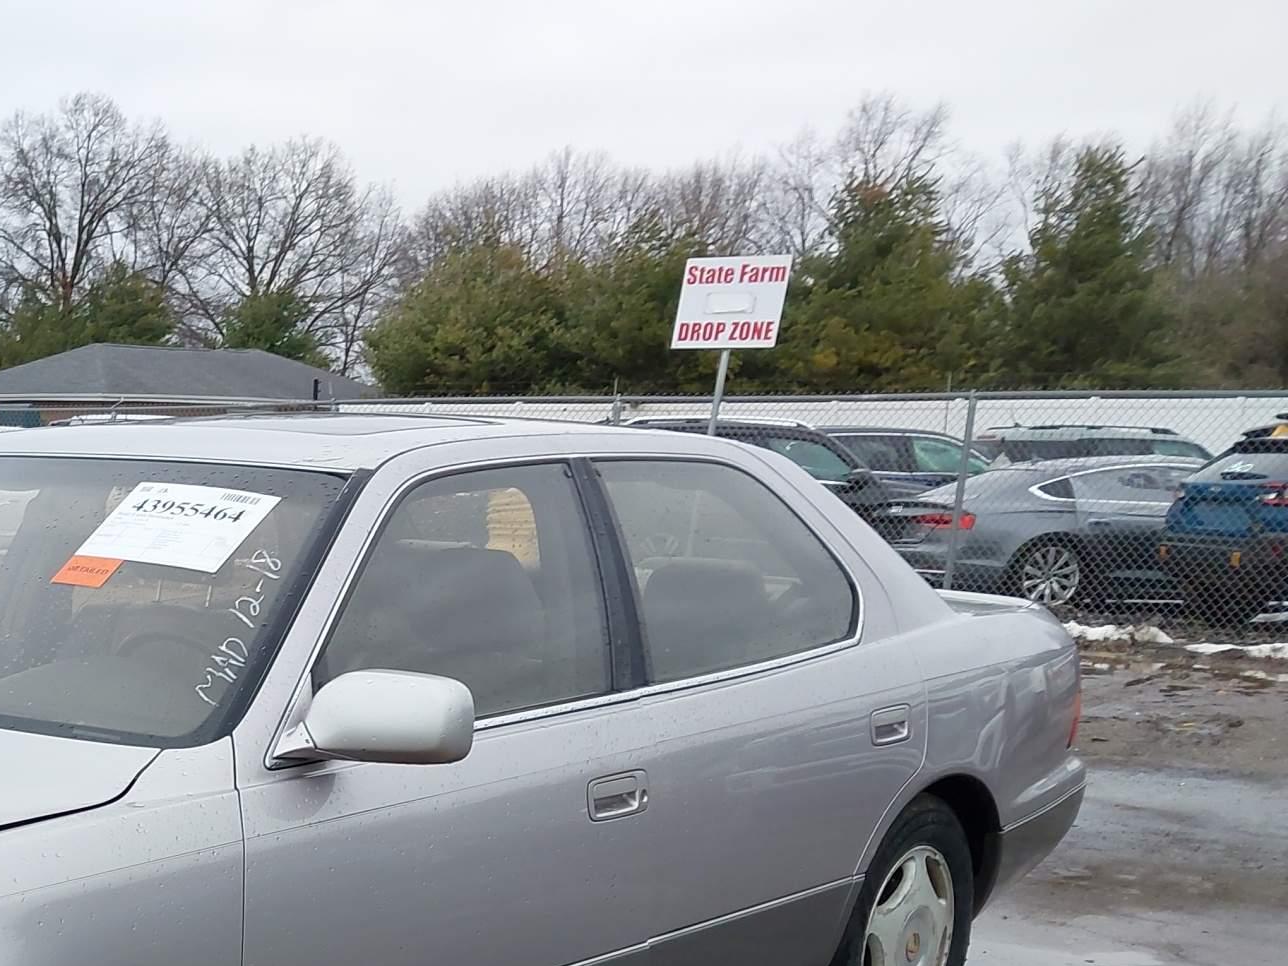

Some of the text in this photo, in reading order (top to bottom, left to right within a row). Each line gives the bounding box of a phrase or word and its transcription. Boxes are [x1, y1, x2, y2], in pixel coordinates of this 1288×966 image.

[687, 264, 787, 285] State Farm
[678, 321, 774, 341] DROP ZONE
[132, 497, 245, 523] 43955464
